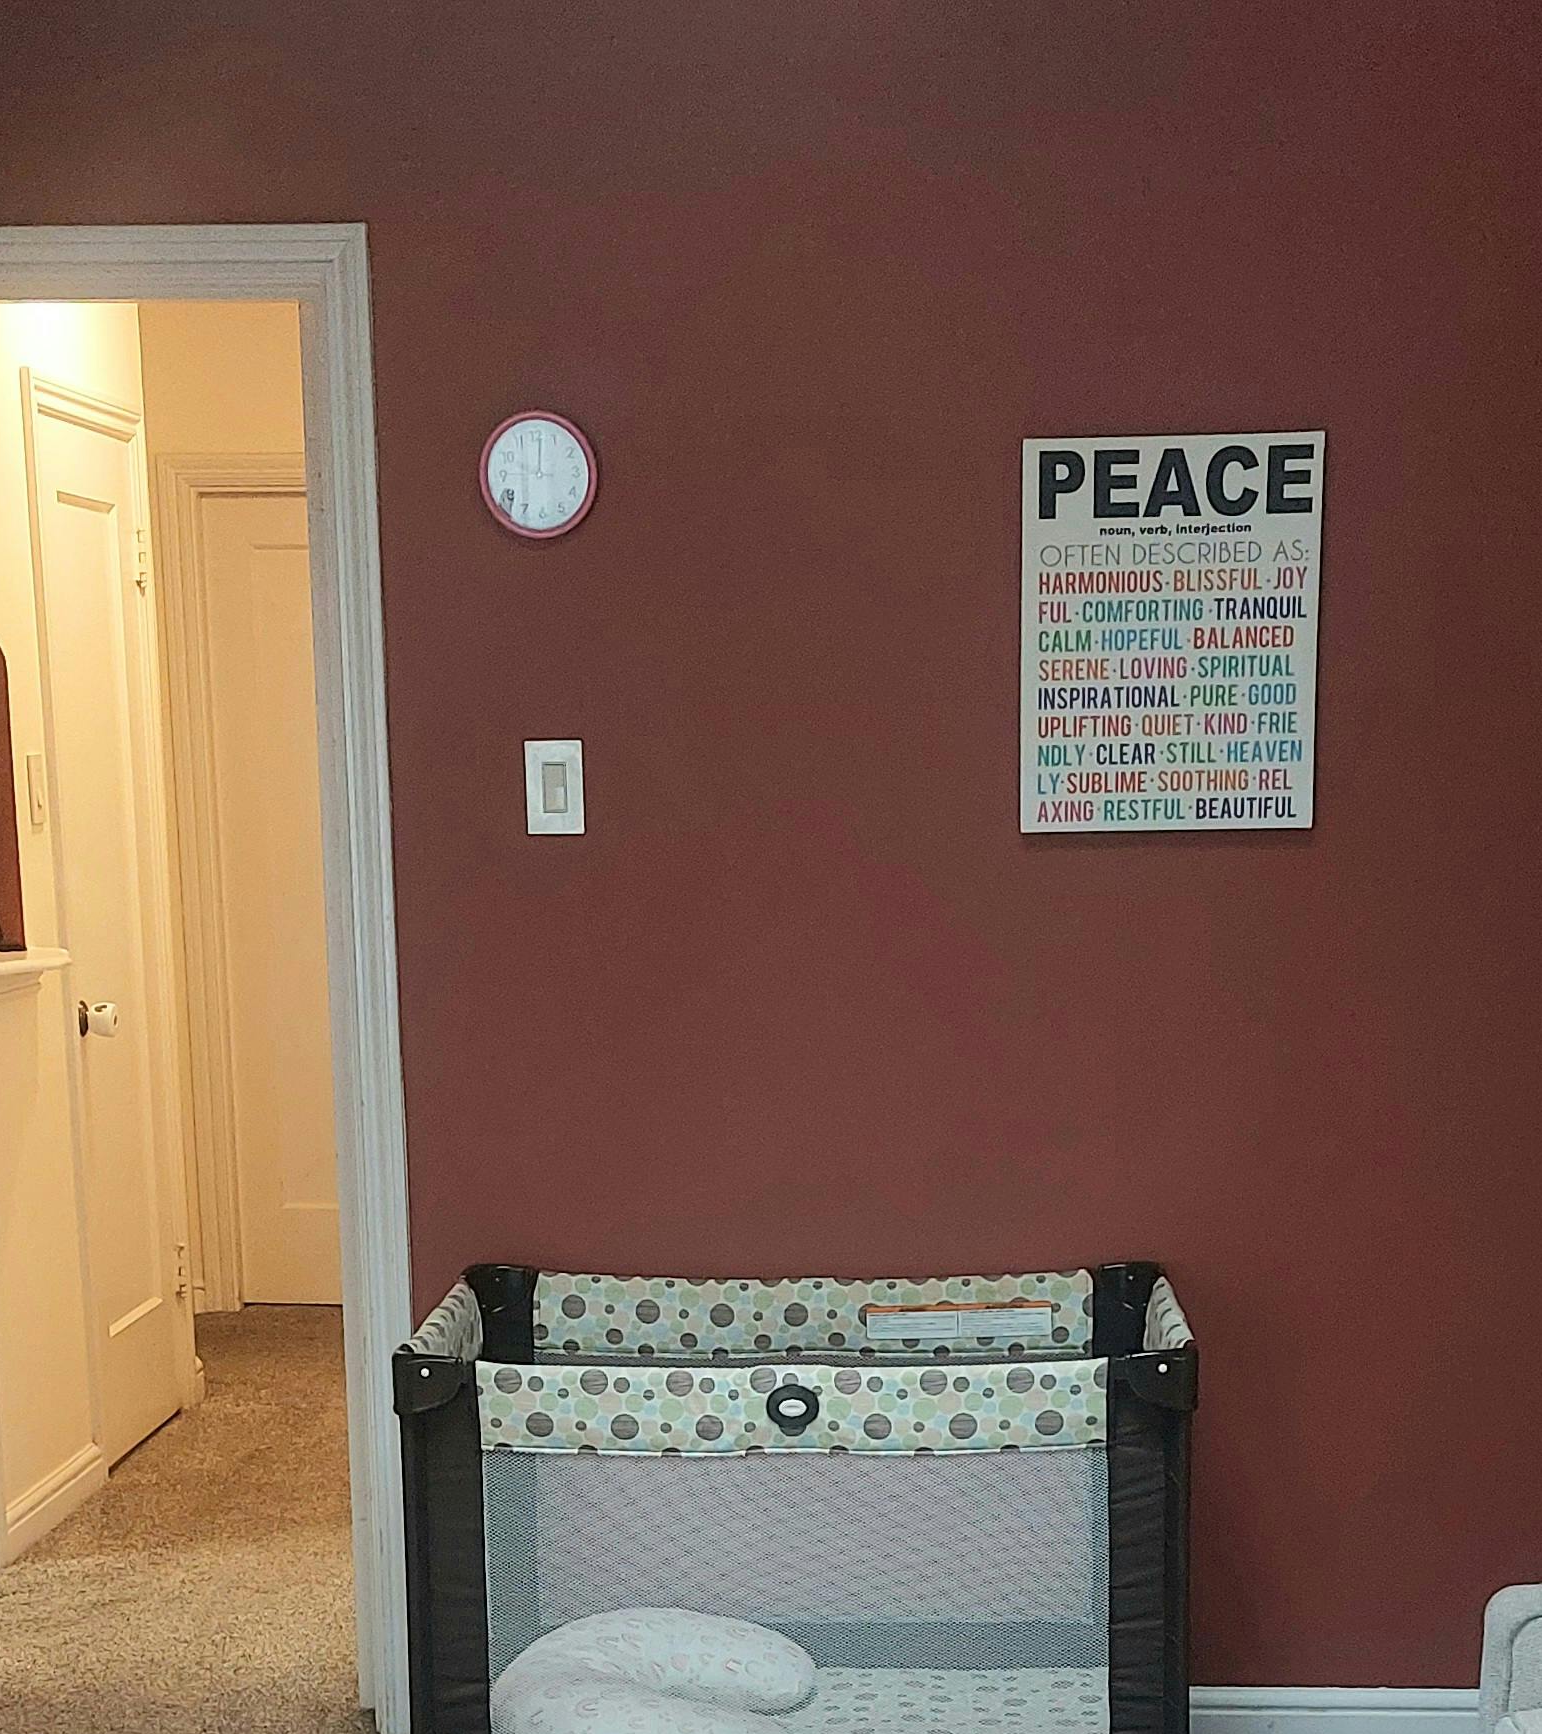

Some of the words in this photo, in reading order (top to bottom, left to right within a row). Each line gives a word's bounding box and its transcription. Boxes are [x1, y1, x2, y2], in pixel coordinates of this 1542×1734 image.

[1038, 444, 1315, 519] PEACE
[1099, 526, 1136, 537] noun,
[1139, 524, 1172, 537] verb,
[1176, 523, 1252, 536] interjection
[1040, 544, 1120, 567] OFTEN
[1133, 541, 1262, 565] DESCRIBED
[1273, 539, 1309, 562] AS:
[1038, 570, 1163, 595] HARMONIOUS
[1174, 568, 1263, 593] BLISSFUL
[1273, 566, 1308, 590] JOY
[1038, 601, 1072, 624] FUL
[1082, 598, 1203, 623] COMFORTING
[1213, 596, 1308, 621] TRANQUIL
[1038, 629, 1092, 653] CALM
[1101, 628, 1183, 652] HOPEFUL
[1193, 625, 1295, 649] BALANCED
[1038, 658, 1110, 682] SERENE
[1119, 656, 1188, 680] LOVING
[1197, 654, 1295, 678] SPIRITUAL
[1037, 685, 1180, 711] INSPIRATIONAL
[1190, 684, 1239, 707] PURE
[1248, 683, 1297, 706] GOOD
[1037, 714, 1132, 739] UPLIFTING
[1142, 713, 1195, 737] QUIET
[1204, 712, 1248, 736] KIND
[1258, 711, 1298, 735] FRIE
[1037, 744, 1086, 768] NDLY
[1096, 742, 1156, 766] CLEAR
[1166, 741, 1216, 764] STILL
[1226, 740, 1303, 763] HEAVEN
[1037, 772, 1060, 795] LY
[1066, 771, 1148, 795] SUBLIME
[1157, 769, 1249, 792] SOOTHING
[1258, 768, 1293, 791] REL
[1037, 799, 1094, 824] AXING
[1103, 798, 1186, 822] RESTFUL
[1195, 796, 1297, 820] BEAUTIFUL
